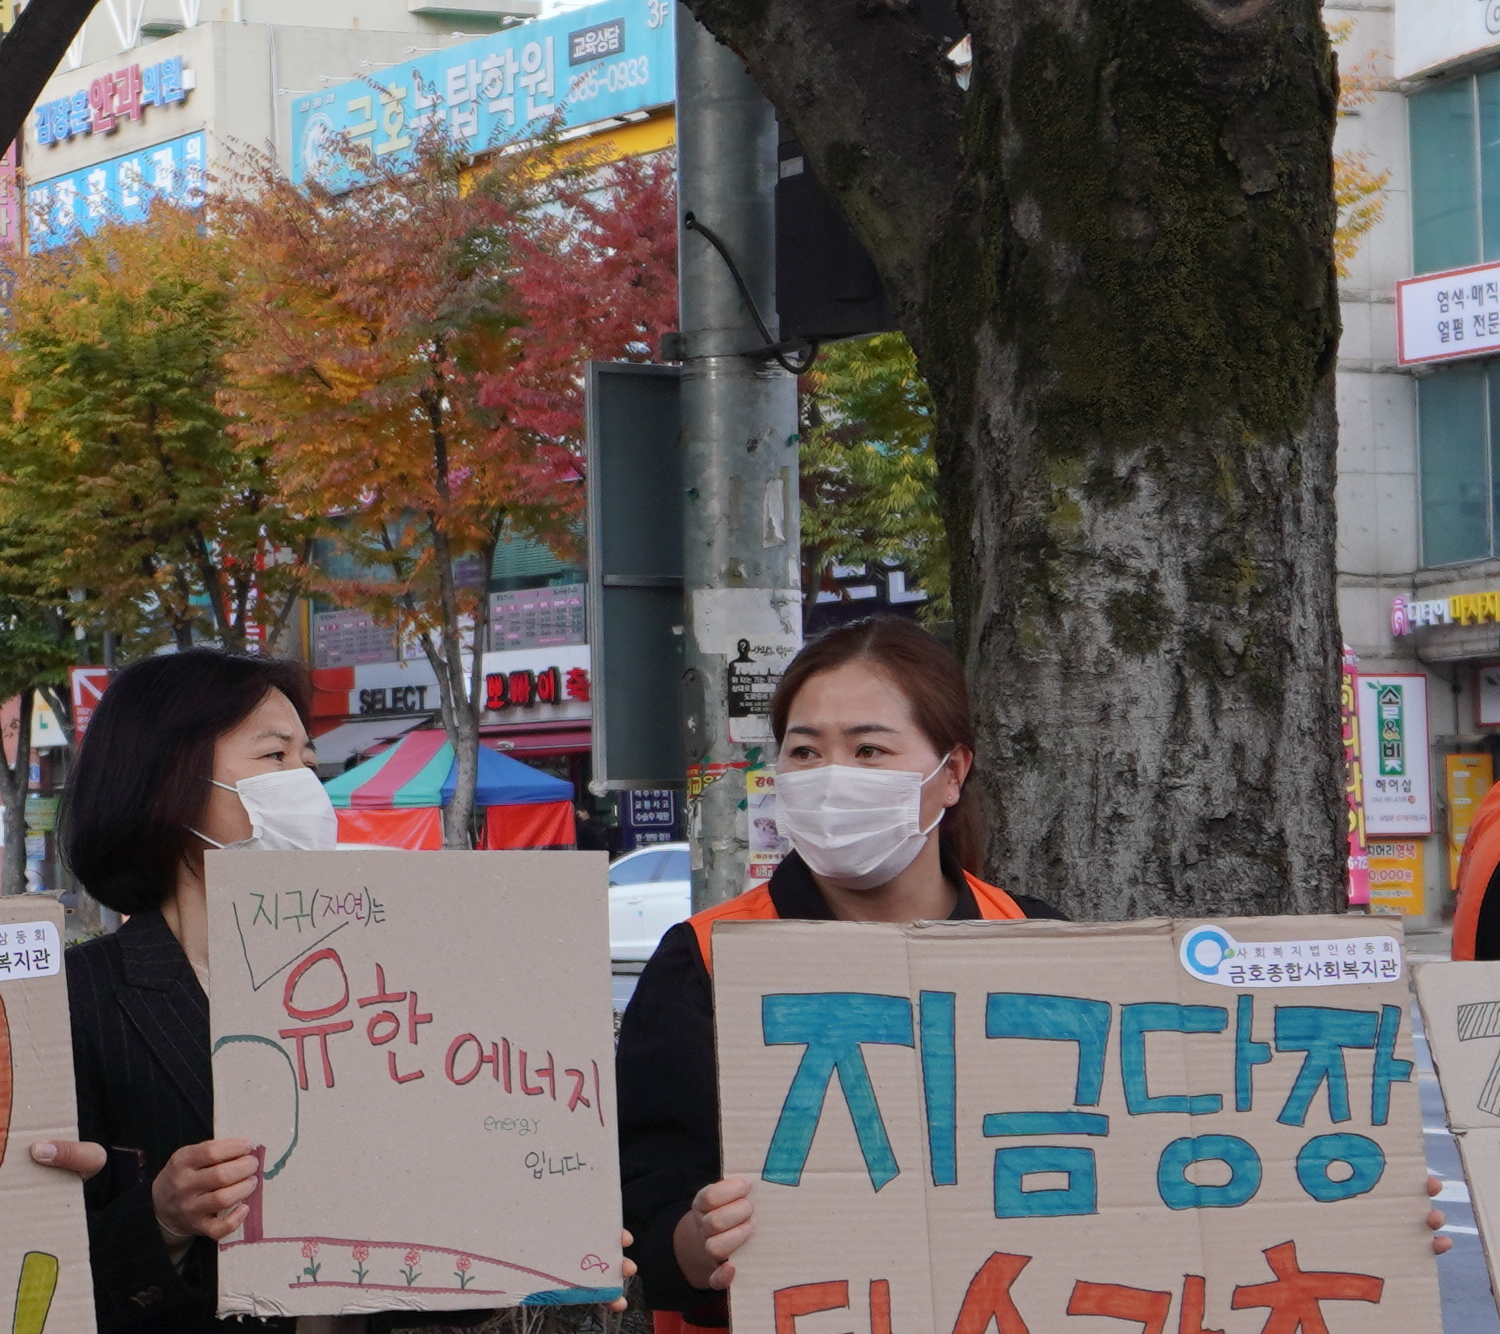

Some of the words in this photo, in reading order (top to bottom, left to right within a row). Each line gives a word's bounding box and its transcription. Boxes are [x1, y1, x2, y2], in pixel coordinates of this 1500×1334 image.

[1471, 311, 1500, 340] 전문
[359, 684, 429, 714] SELECT
[249, 886, 387, 933] 지구(자연)는
[1227, 959, 1399, 985] 금호종합사회복지관
[760, 989, 1414, 1220] 지금당장
[483, 1115, 542, 1137] energy
